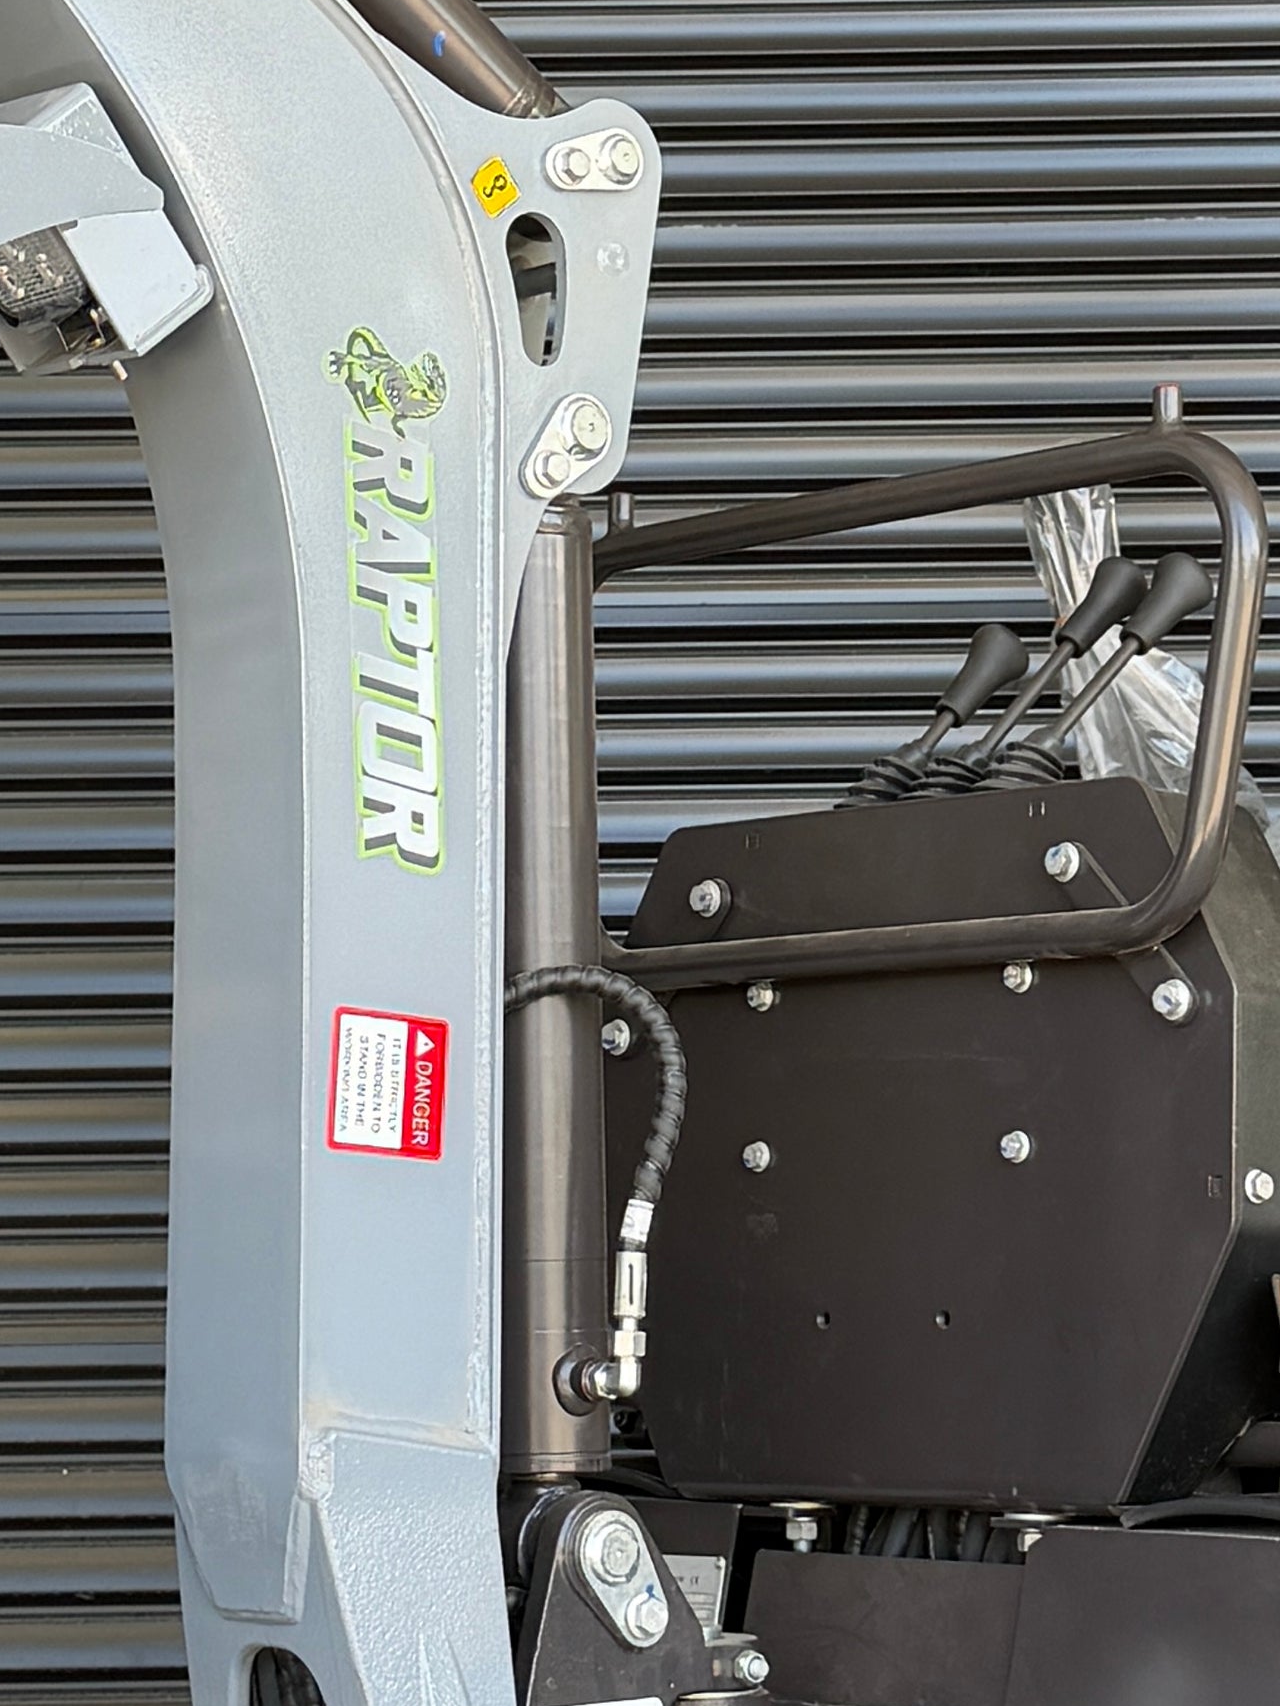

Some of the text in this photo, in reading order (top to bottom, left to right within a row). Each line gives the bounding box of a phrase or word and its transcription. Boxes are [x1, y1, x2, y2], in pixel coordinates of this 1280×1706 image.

[346, 416, 446, 877] RAPTOR
[358, 1036, 368, 1079] STAND
[355, 1101, 365, 1126] THE
[371, 1117, 381, 1133] TO
[411, 1061, 433, 1146] DANGER
